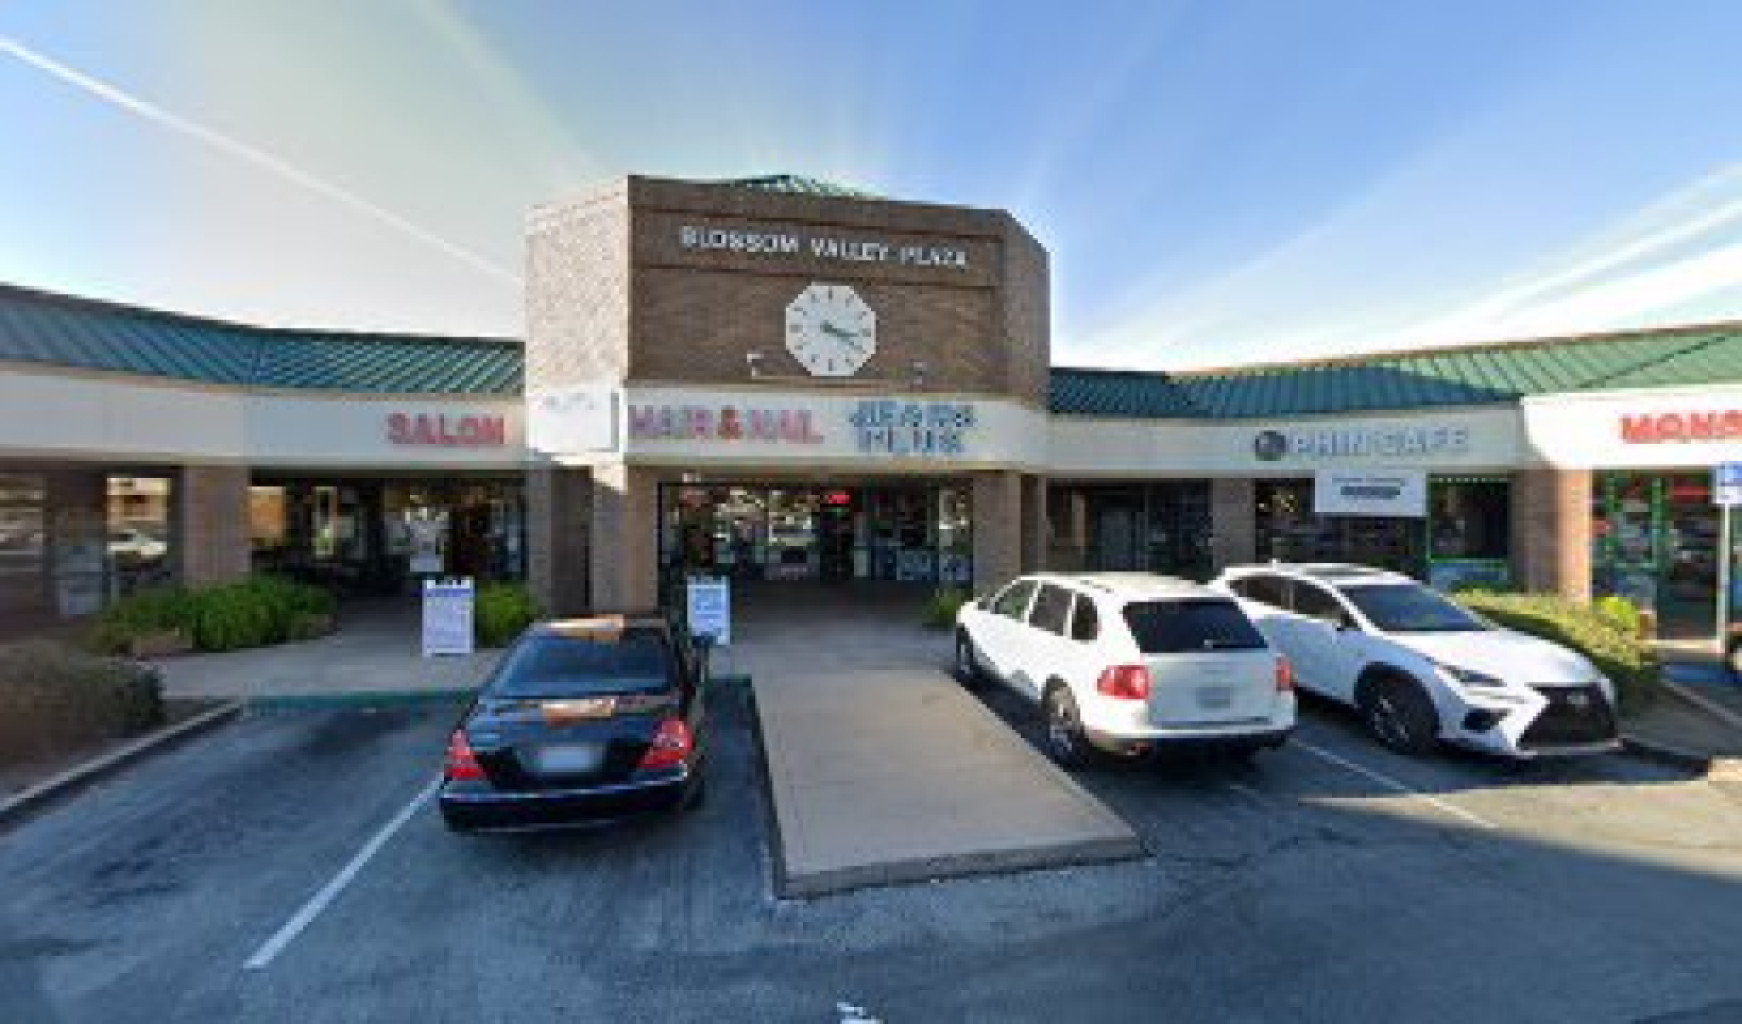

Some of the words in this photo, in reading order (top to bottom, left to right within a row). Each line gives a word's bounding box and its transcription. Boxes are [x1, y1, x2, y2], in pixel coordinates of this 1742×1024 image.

[680, 226, 799, 253] BLOSSOM
[811, 238, 888, 261] VALLEY
[900, 247, 967, 268] PLAZA
[387, 411, 505, 446] SALON
[628, 406, 714, 442] HAIR
[718, 409, 743, 442] &
[749, 410, 826, 444] NAIL
[1374, 426, 1470, 456] CAFE
